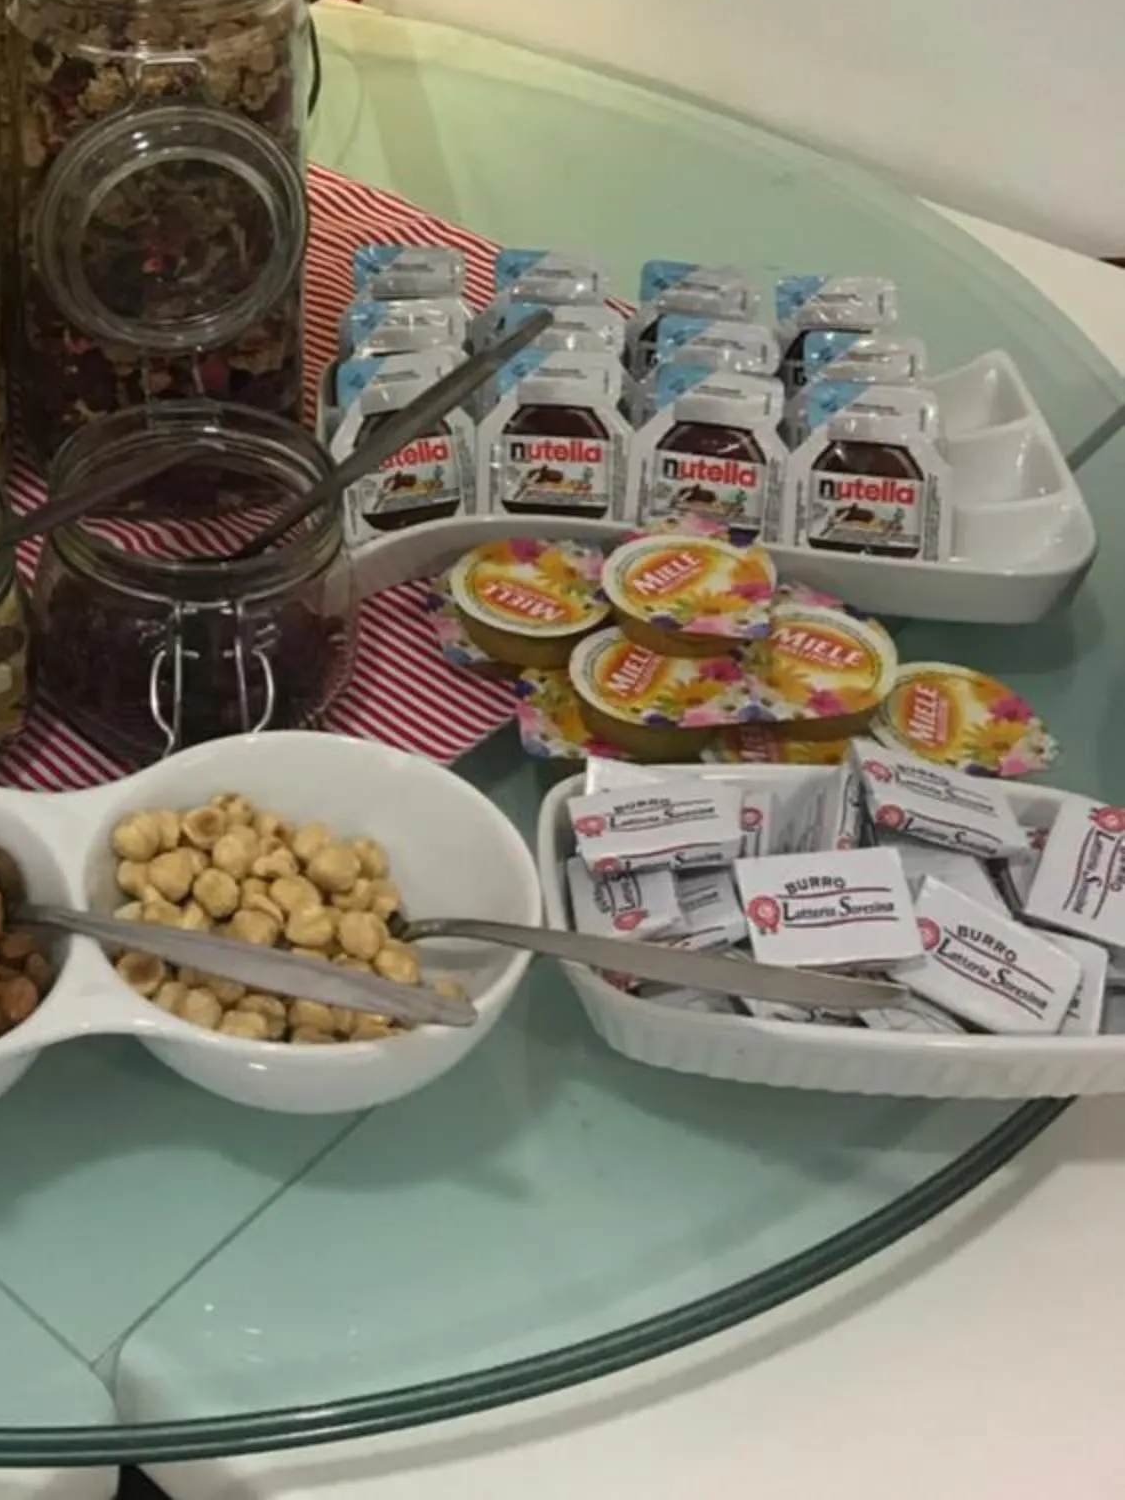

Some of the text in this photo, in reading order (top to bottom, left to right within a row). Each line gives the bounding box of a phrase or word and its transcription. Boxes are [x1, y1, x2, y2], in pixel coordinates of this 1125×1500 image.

[510, 440, 602, 463] nutella
[661, 457, 757, 488] nutella
[818, 476, 915, 505] nutella
[632, 551, 701, 596] MIELE
[478, 581, 567, 622] MIELE
[770, 627, 865, 667] MIELE
[907, 683, 939, 748] MIELE
[784, 875, 847, 895] BURRO
[956, 924, 1018, 962] BURRO
